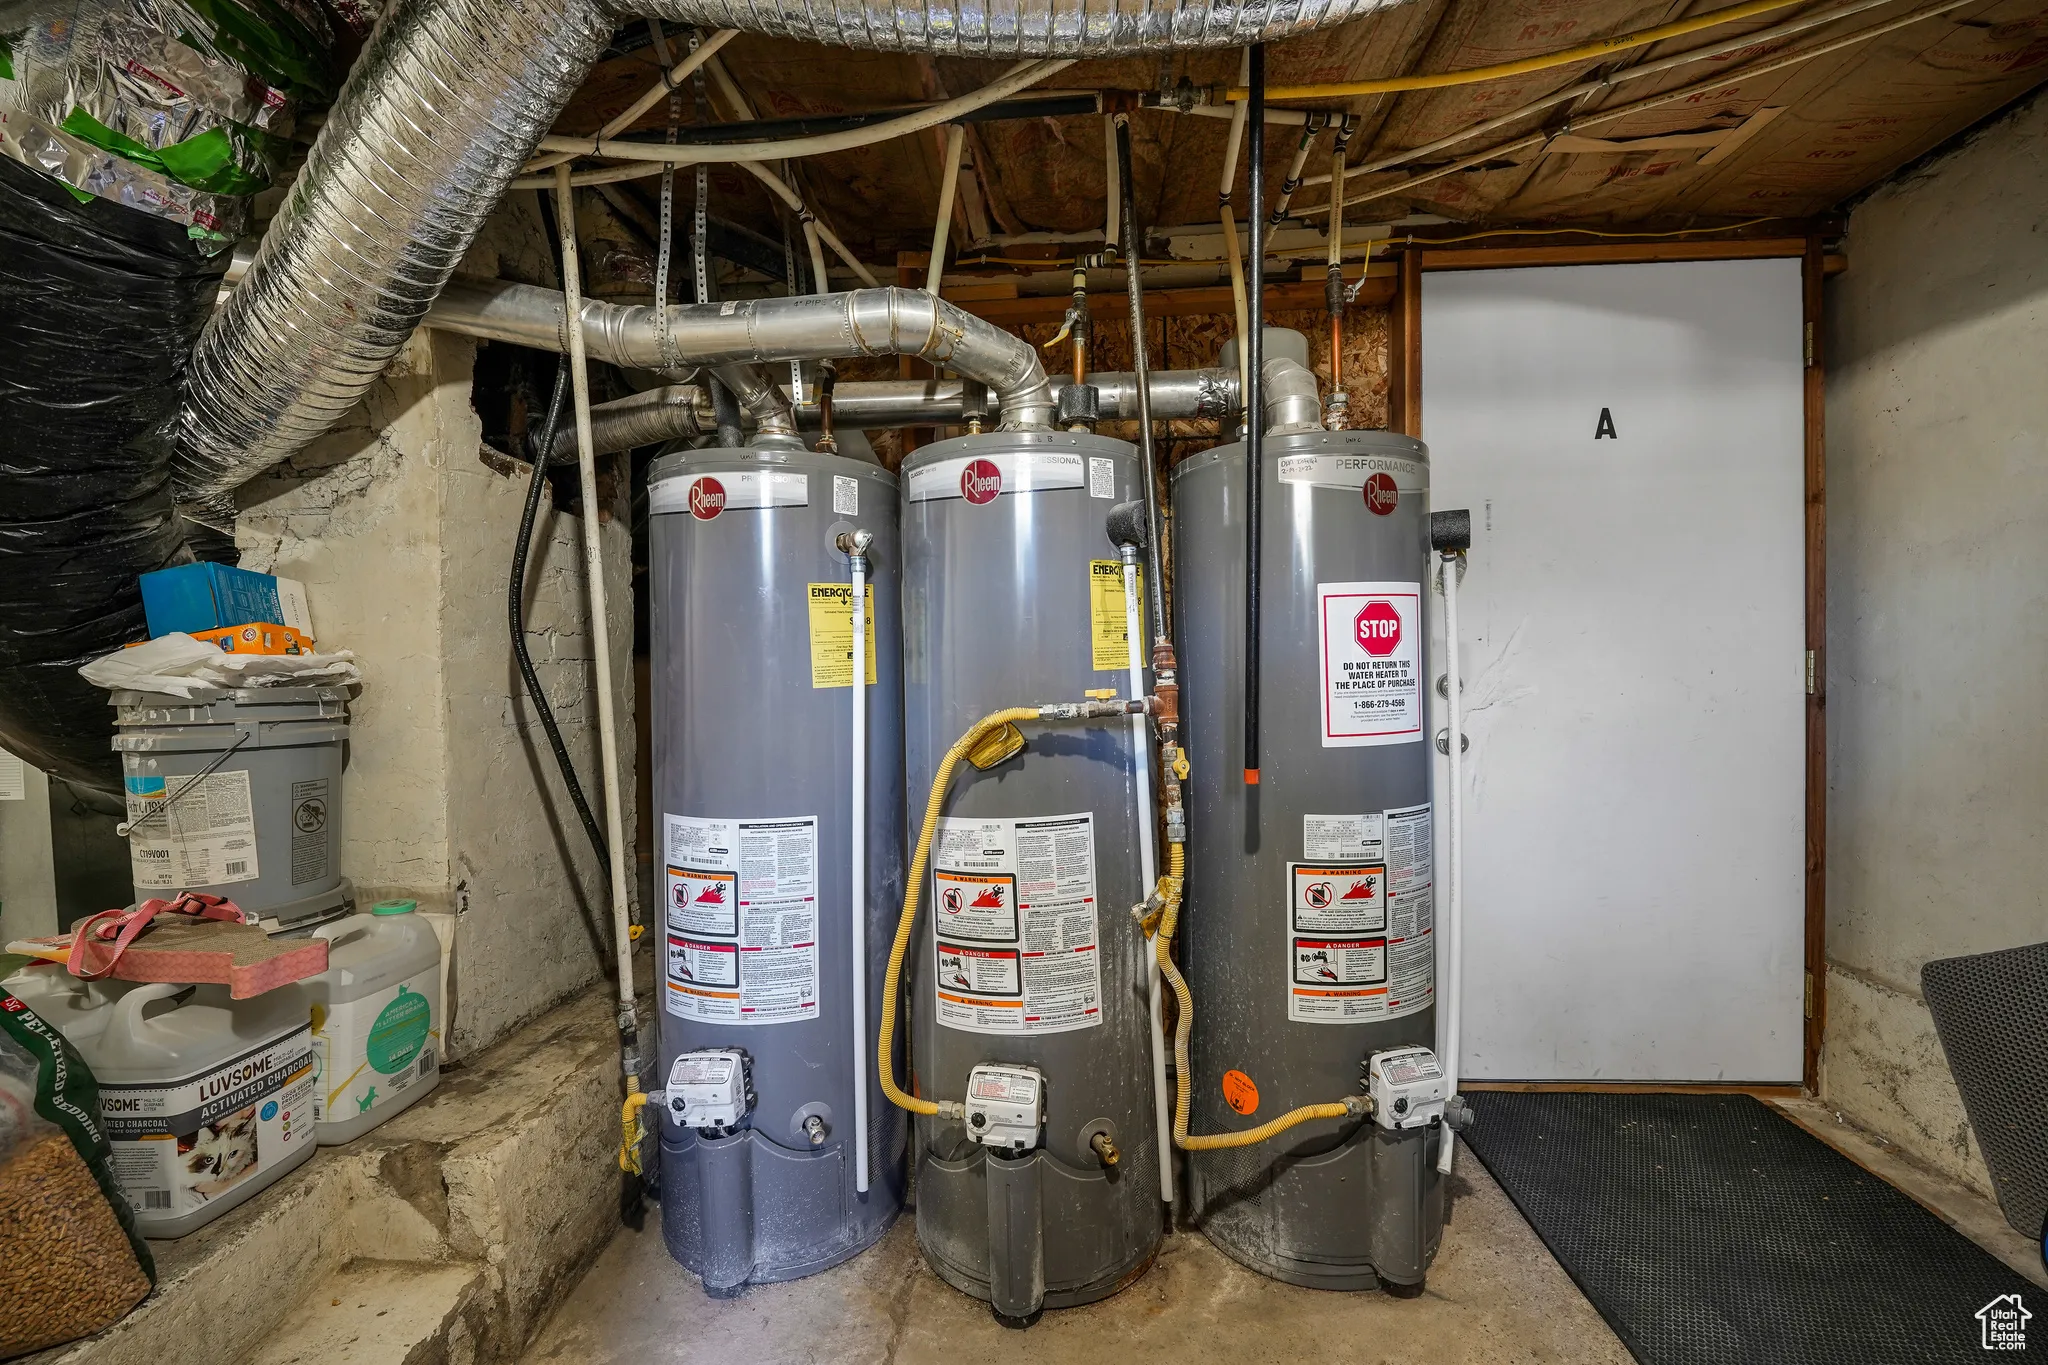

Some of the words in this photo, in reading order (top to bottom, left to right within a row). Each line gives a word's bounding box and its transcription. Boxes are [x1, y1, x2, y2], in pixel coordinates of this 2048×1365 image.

[1594, 408, 1617, 440] A
[1336, 460, 1416, 474] PERFORMANCE
[964, 462, 1000, 498] Rheem
[1368, 474, 1397, 509] Rheem
[692, 478, 724, 514] Rheem
[1360, 620, 1398, 638] STOP
[1343, 662, 1354, 670] DO
[1372, 661, 1397, 669] RETURN
[1399, 660, 1410, 668] THIS
[1348, 671, 1374, 680] WATER
[1376, 670, 1399, 678] HEATER
[1400, 670, 1408, 678] TO
[1335, 682, 1350, 690] THE
[1352, 681, 1375, 689] PLACE
[1378, 680, 1386, 688] OF
[1388, 678, 1416, 688] PURCHASE
[1354, 699, 1405, 708] 1-866-279-4566
[383, 1011, 405, 1026] LITTER
[17, 1010, 68, 1092] PELLETIZED
[200, 1054, 273, 1102] LUVSOME
[201, 1080, 264, 1118] ACTIVATED
[268, 1054, 312, 1086] CHARCOAL
[52, 1094, 102, 1144] BEDDING
[201, 1118, 214, 1126] FOR
